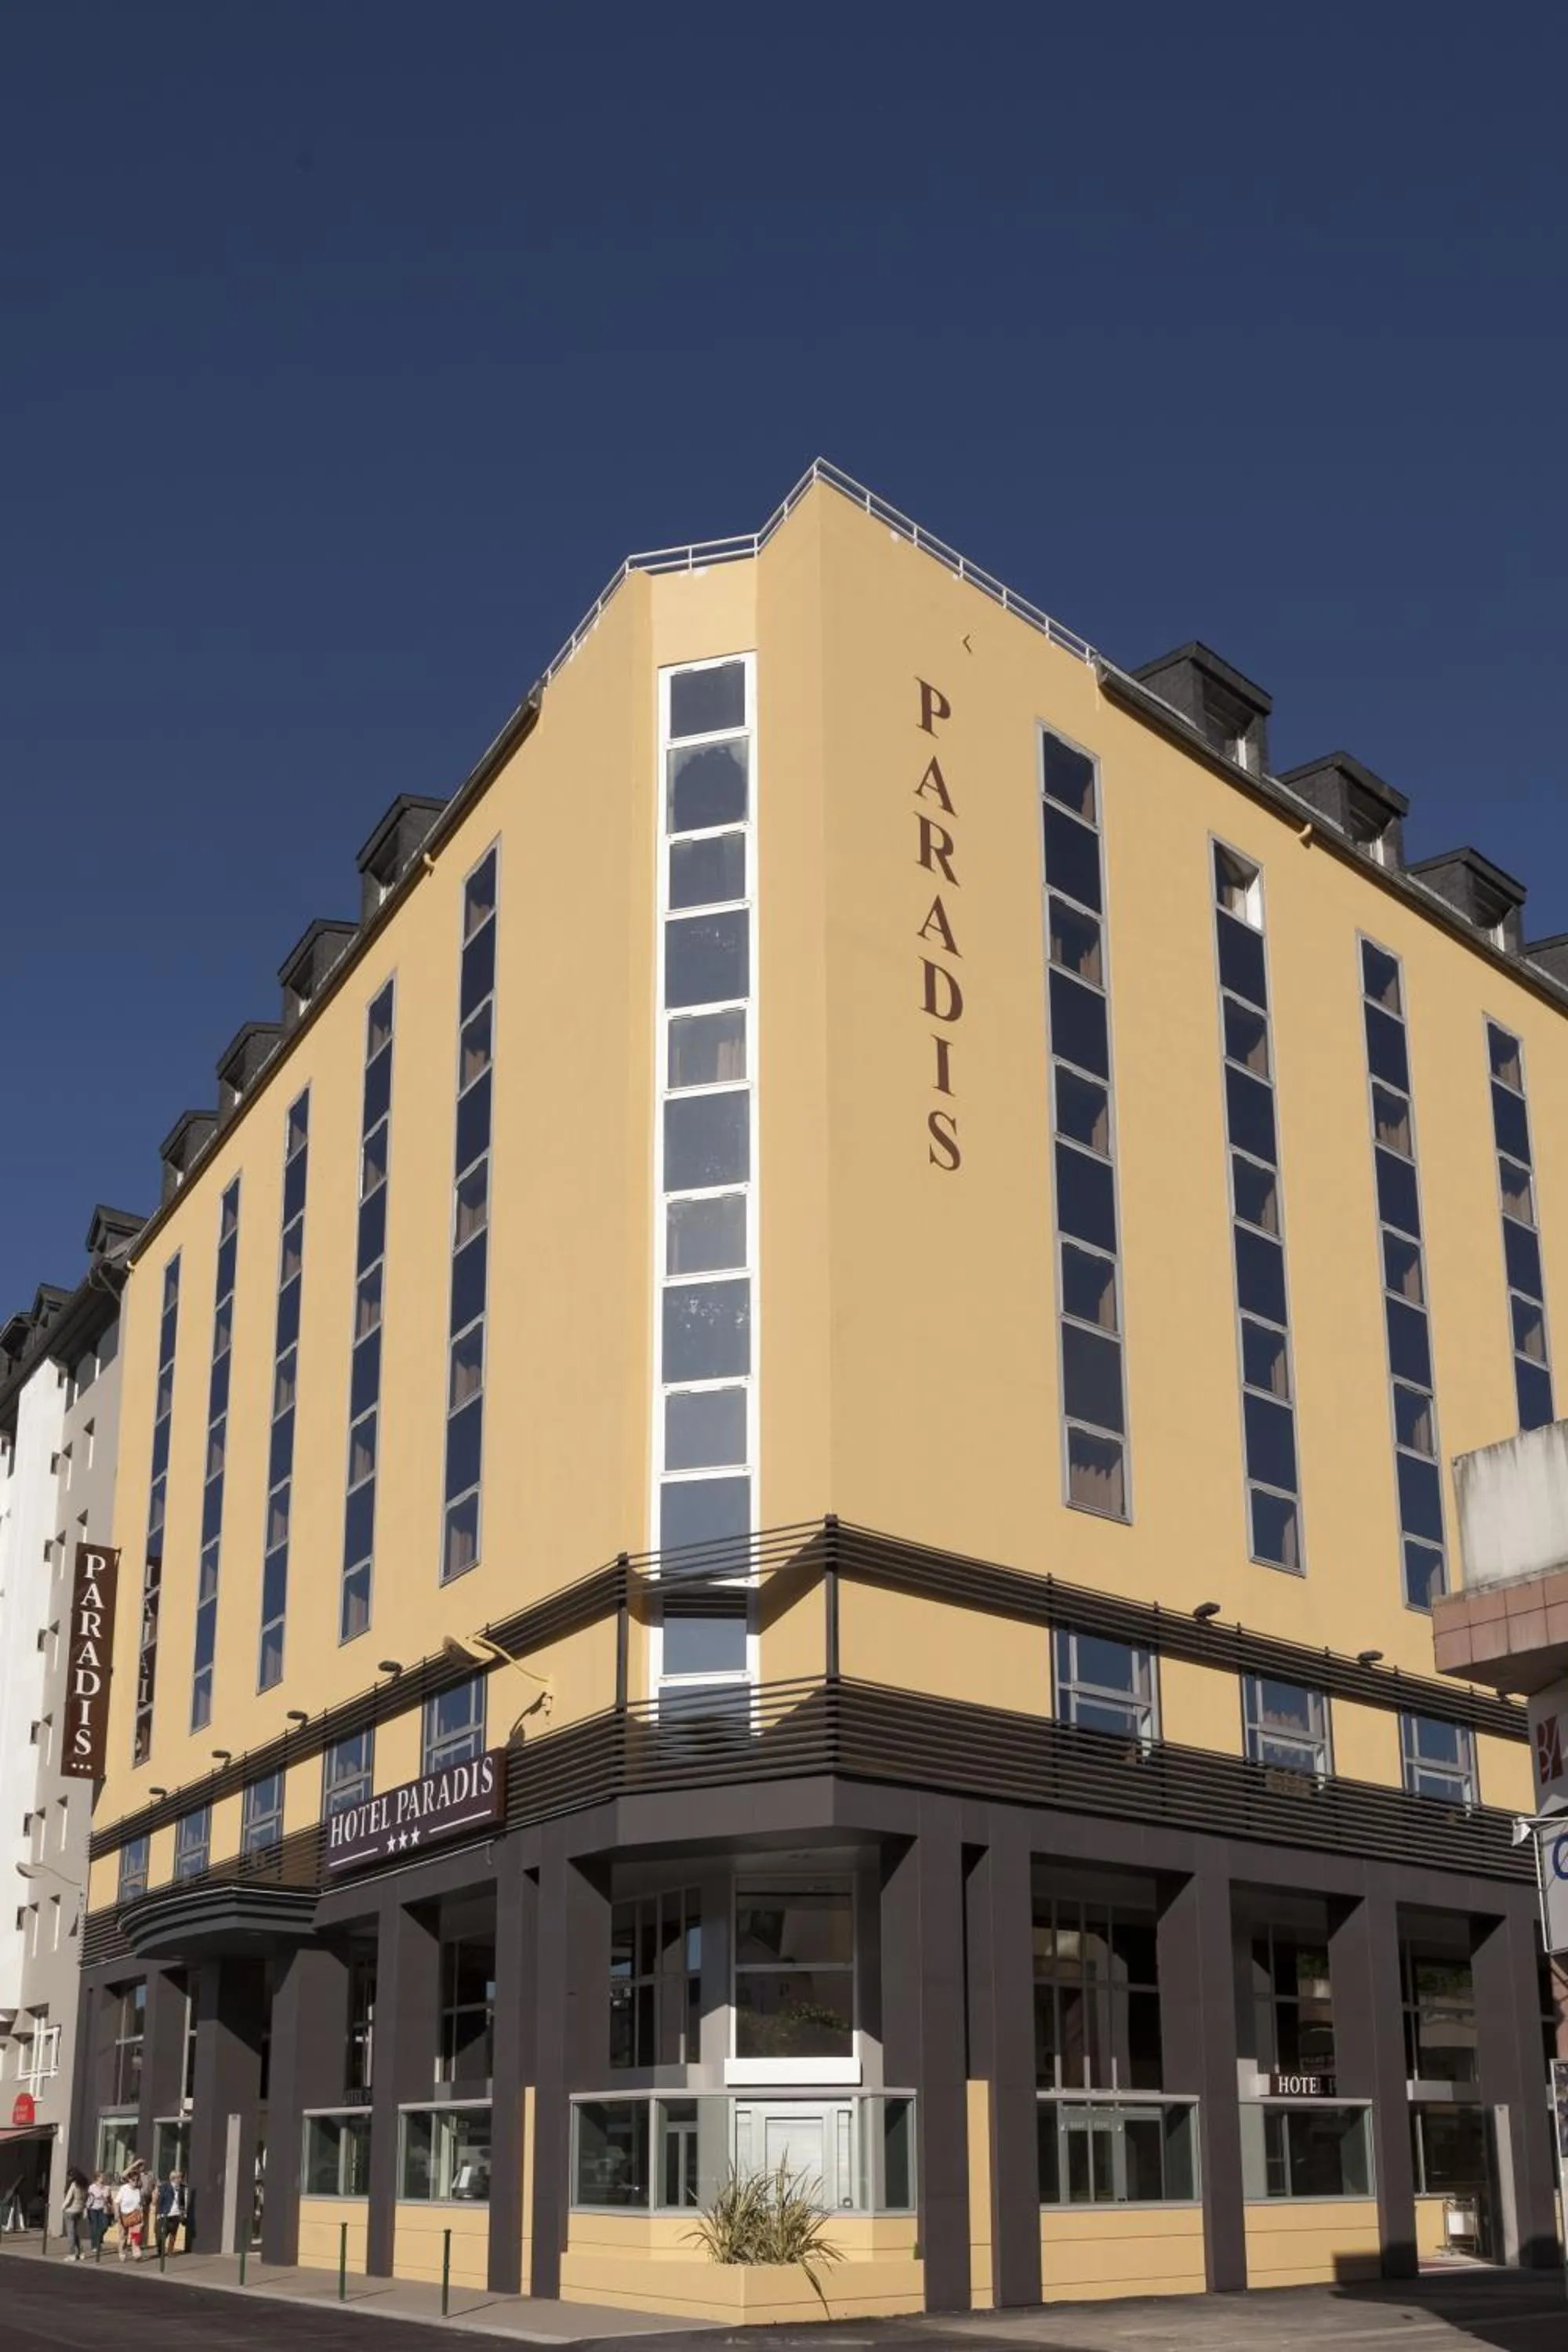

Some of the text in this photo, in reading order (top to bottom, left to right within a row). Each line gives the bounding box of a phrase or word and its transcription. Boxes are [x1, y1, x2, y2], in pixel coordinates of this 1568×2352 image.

[914, 677, 964, 1171] PARADIS
[74, 1552, 107, 1755] PARADIS
[330, 1756, 493, 1849] HOTEL PARADIS
